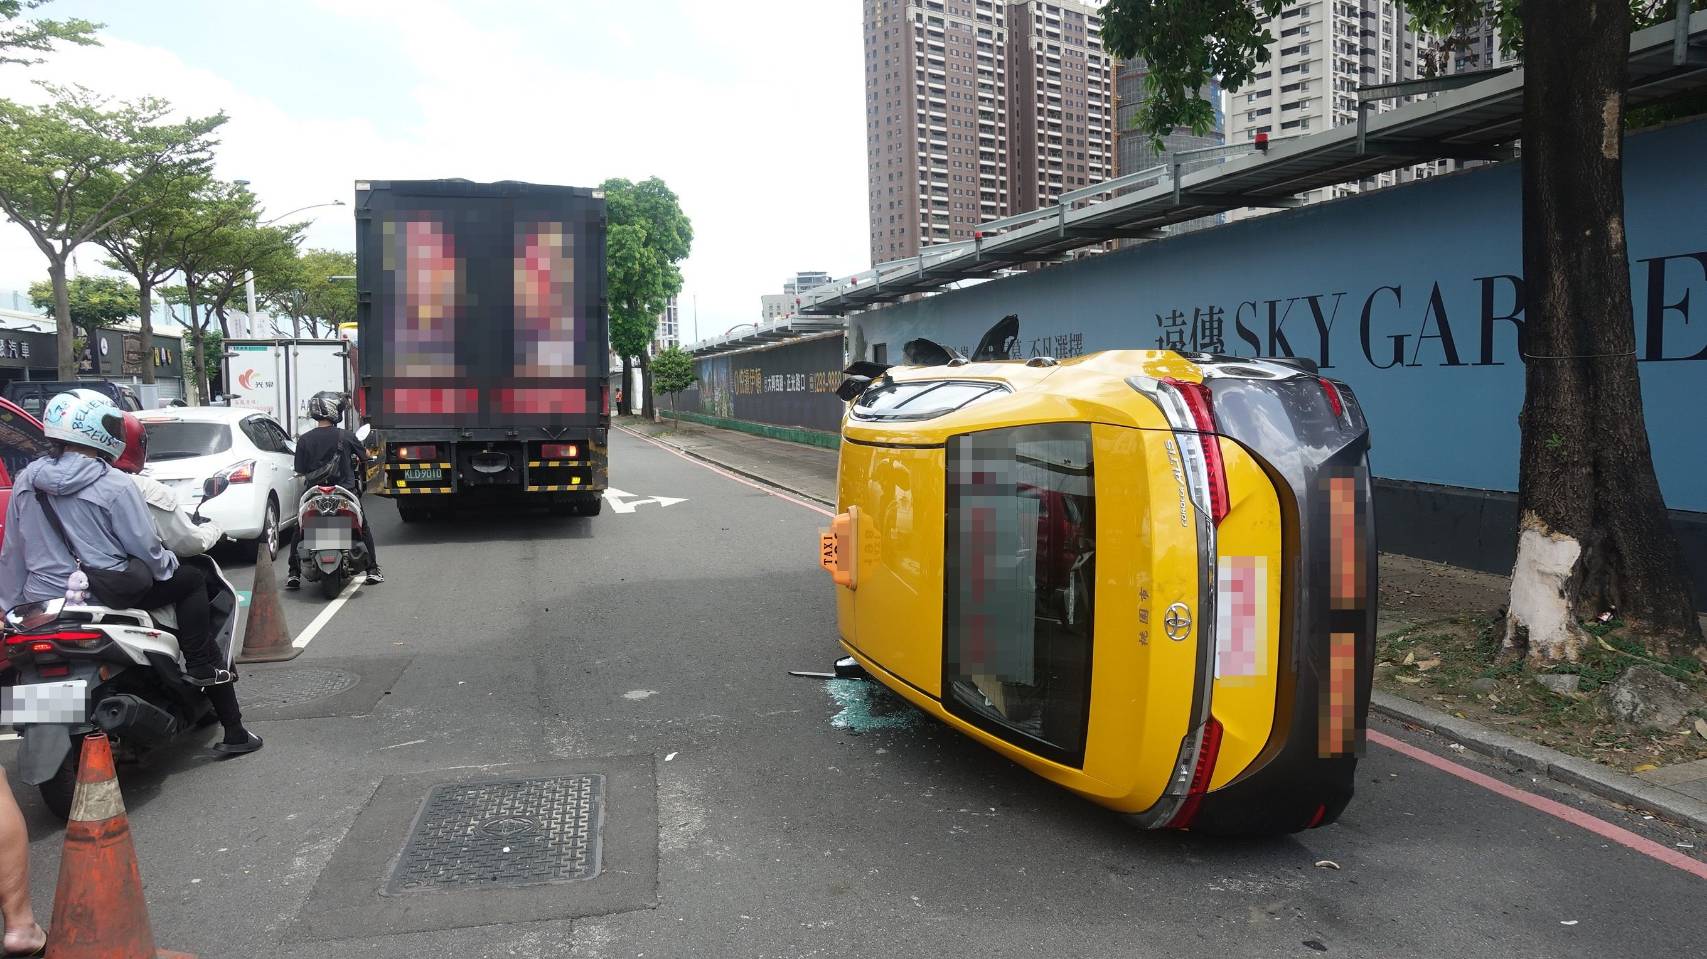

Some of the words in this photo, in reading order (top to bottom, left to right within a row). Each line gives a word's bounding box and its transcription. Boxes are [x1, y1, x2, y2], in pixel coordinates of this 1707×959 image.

[1235, 292, 1348, 369] SKY
[1359, 252, 1707, 370] GARE
[1164, 439, 1185, 486] ALTIS
[823, 536, 833, 565] TAXI
[1138, 586, 1149, 646] 桃園市
